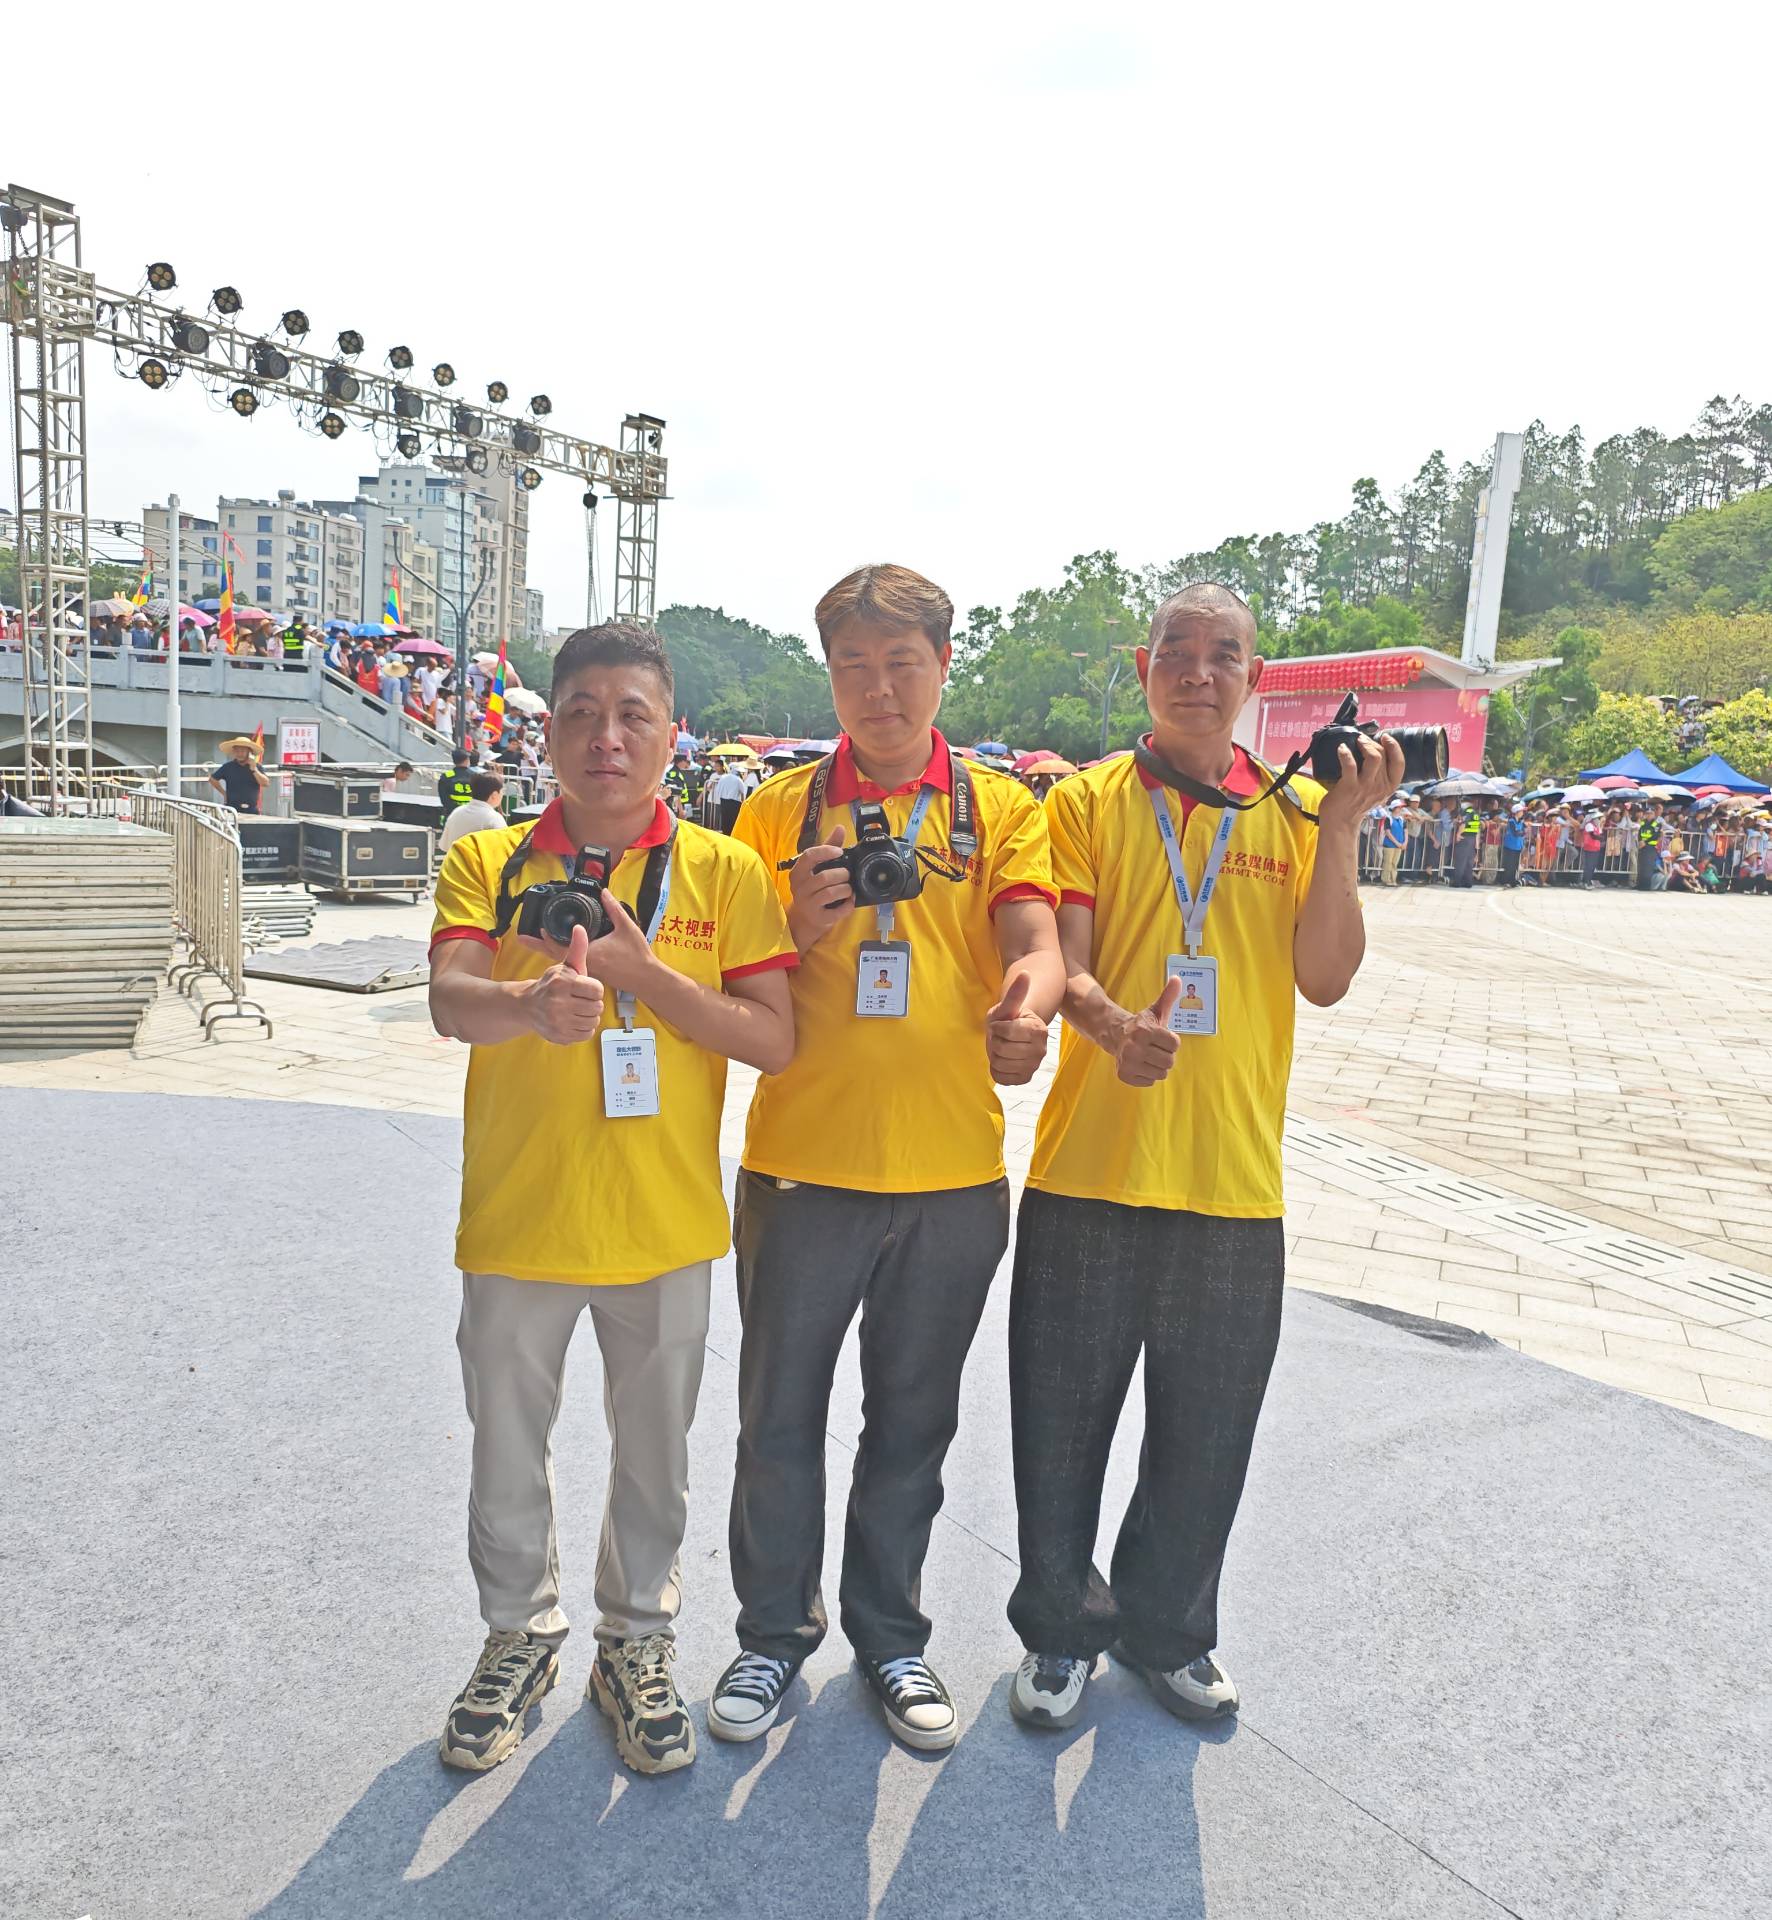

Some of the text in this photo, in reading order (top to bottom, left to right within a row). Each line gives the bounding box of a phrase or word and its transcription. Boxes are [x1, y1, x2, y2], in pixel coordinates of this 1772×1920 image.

[808, 769, 827, 822] EOS 60D
[956, 782, 968, 822] Canon
[865, 834, 886, 842] Canon
[574, 877, 595, 887] Canon
